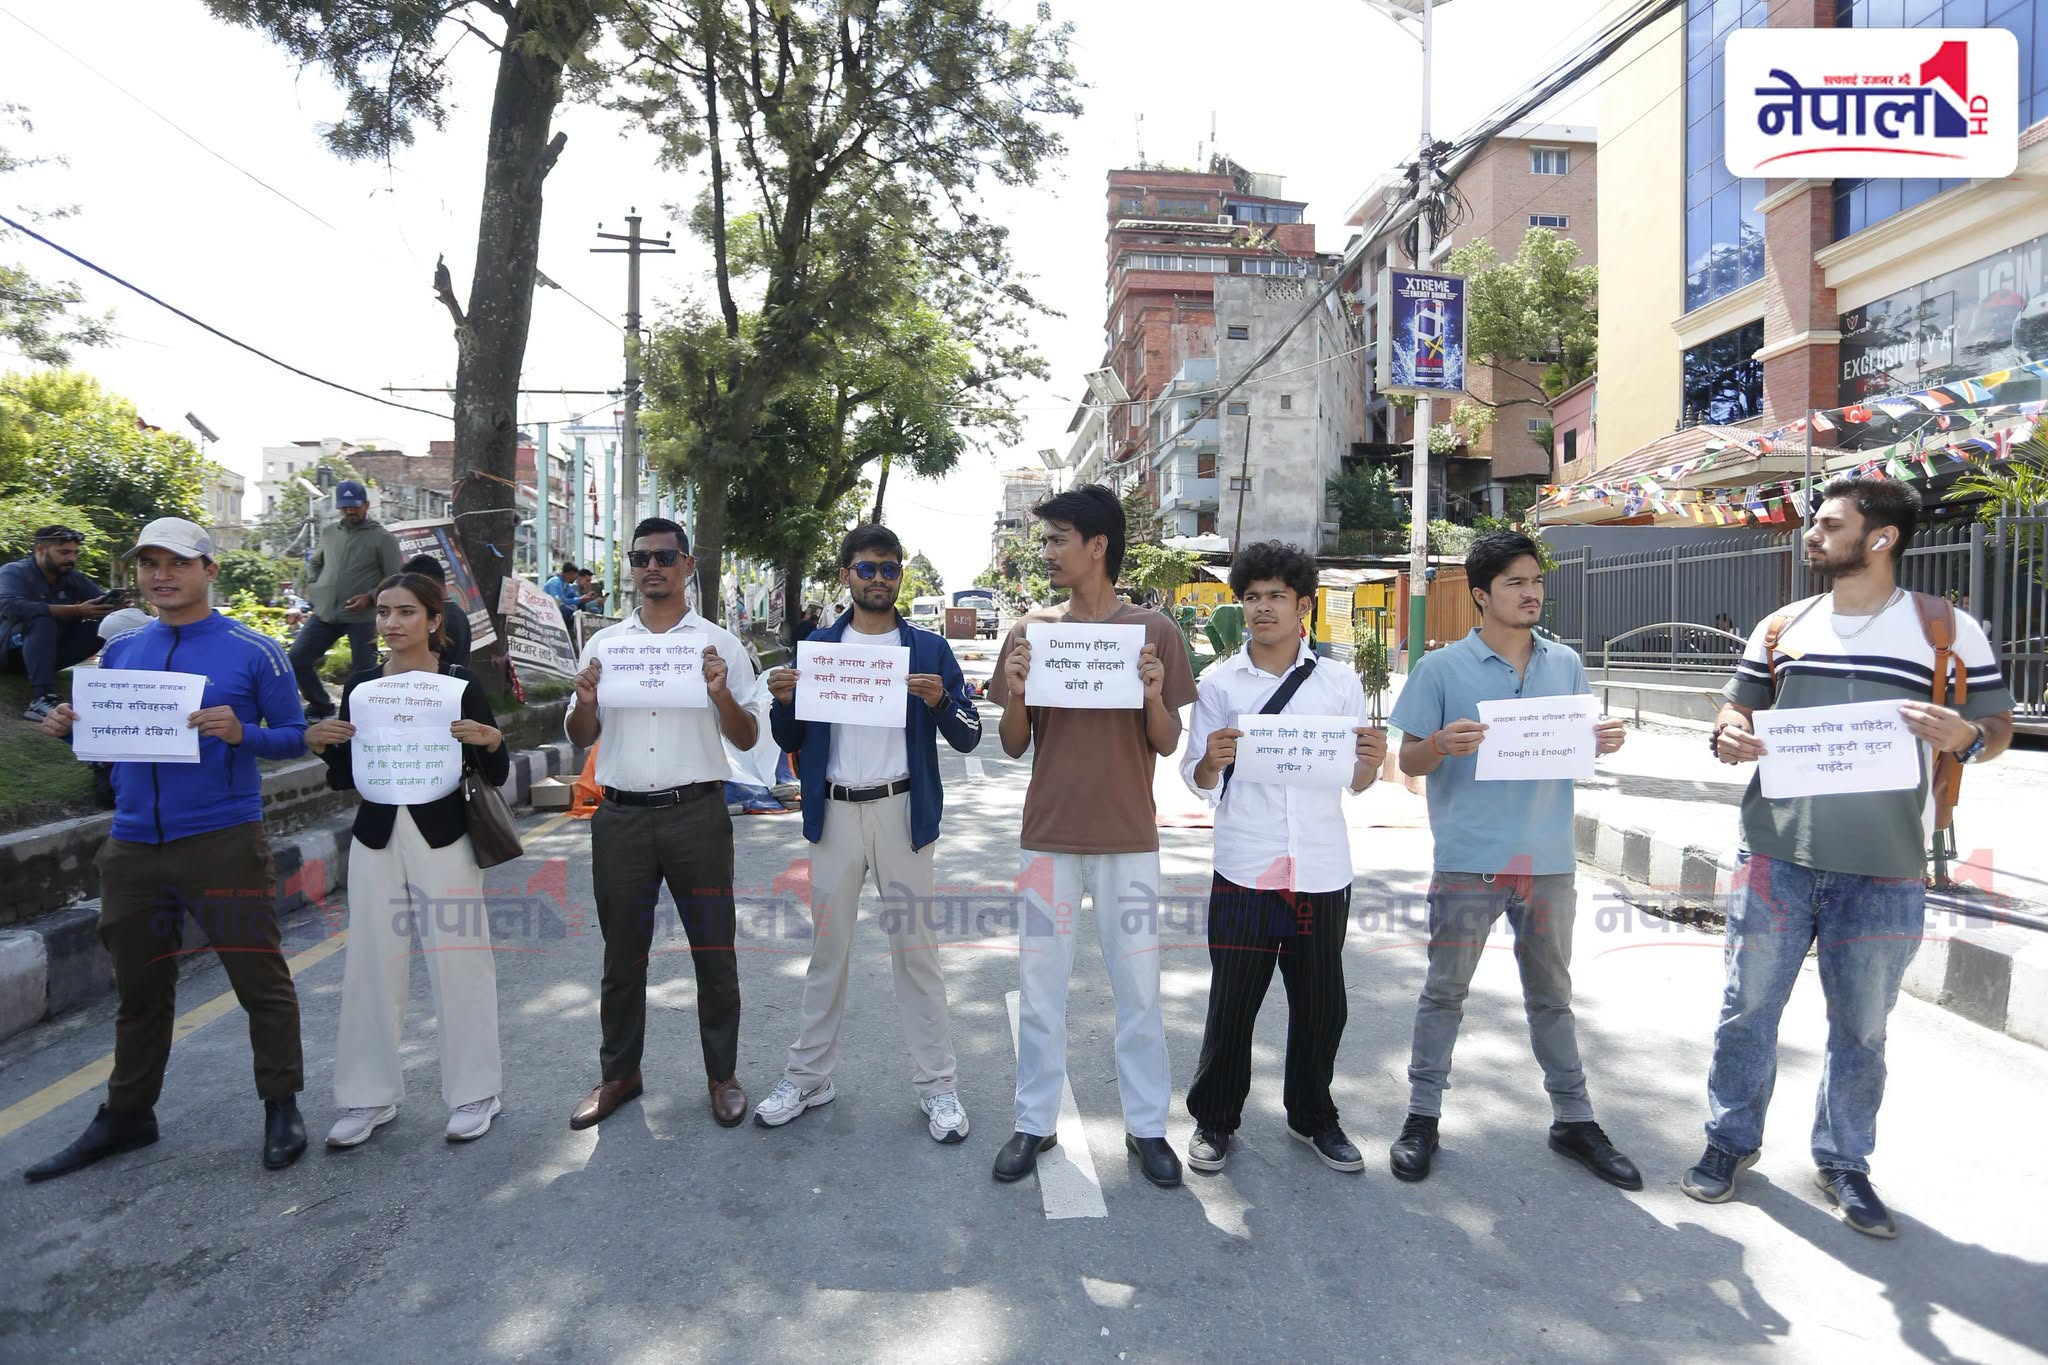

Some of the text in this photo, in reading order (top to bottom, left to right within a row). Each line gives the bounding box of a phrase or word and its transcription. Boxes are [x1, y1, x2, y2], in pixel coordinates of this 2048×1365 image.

[1405, 277, 1450, 293] XTREME
[1410, 290, 1430, 298] ENERGY
[1843, 332, 1936, 381] EXCLUSIVELY
[608, 645, 635, 655] स्वकीय
[1050, 639, 1120, 651] Dummy होइन,
[612, 663, 645, 671] जनताको
[649, 662, 670, 675] ढुकुटी
[813, 656, 893, 670] पहिले अपराध अहिले
[377, 681, 409, 689] जनताको
[814, 673, 891, 687] कसरी गंगाजल भयो
[1094, 681, 1103, 691] हो
[819, 691, 848, 701] स्वकिय
[92, 700, 123, 710] स्वकीय
[405, 696, 442, 708] विलासिता
[393, 713, 415, 722] होइन
[1249, 728, 1273, 737] बालेन
[1278, 728, 1298, 739] तिमी
[1303, 729, 1317, 739] देश
[1768, 724, 1806, 735] स्वकीय
[362, 744, 374, 753] देश
[1301, 746, 1313, 756] कि
[1498, 750, 1530, 758] Enough
[1541, 747, 1576, 757] Enough!
[1776, 741, 1892, 756] जनताको ढुकुटी लुट्न
[378, 760, 388, 768] कि
[392, 761, 421, 769] देशलाई
[425, 761, 444, 769] हासो
